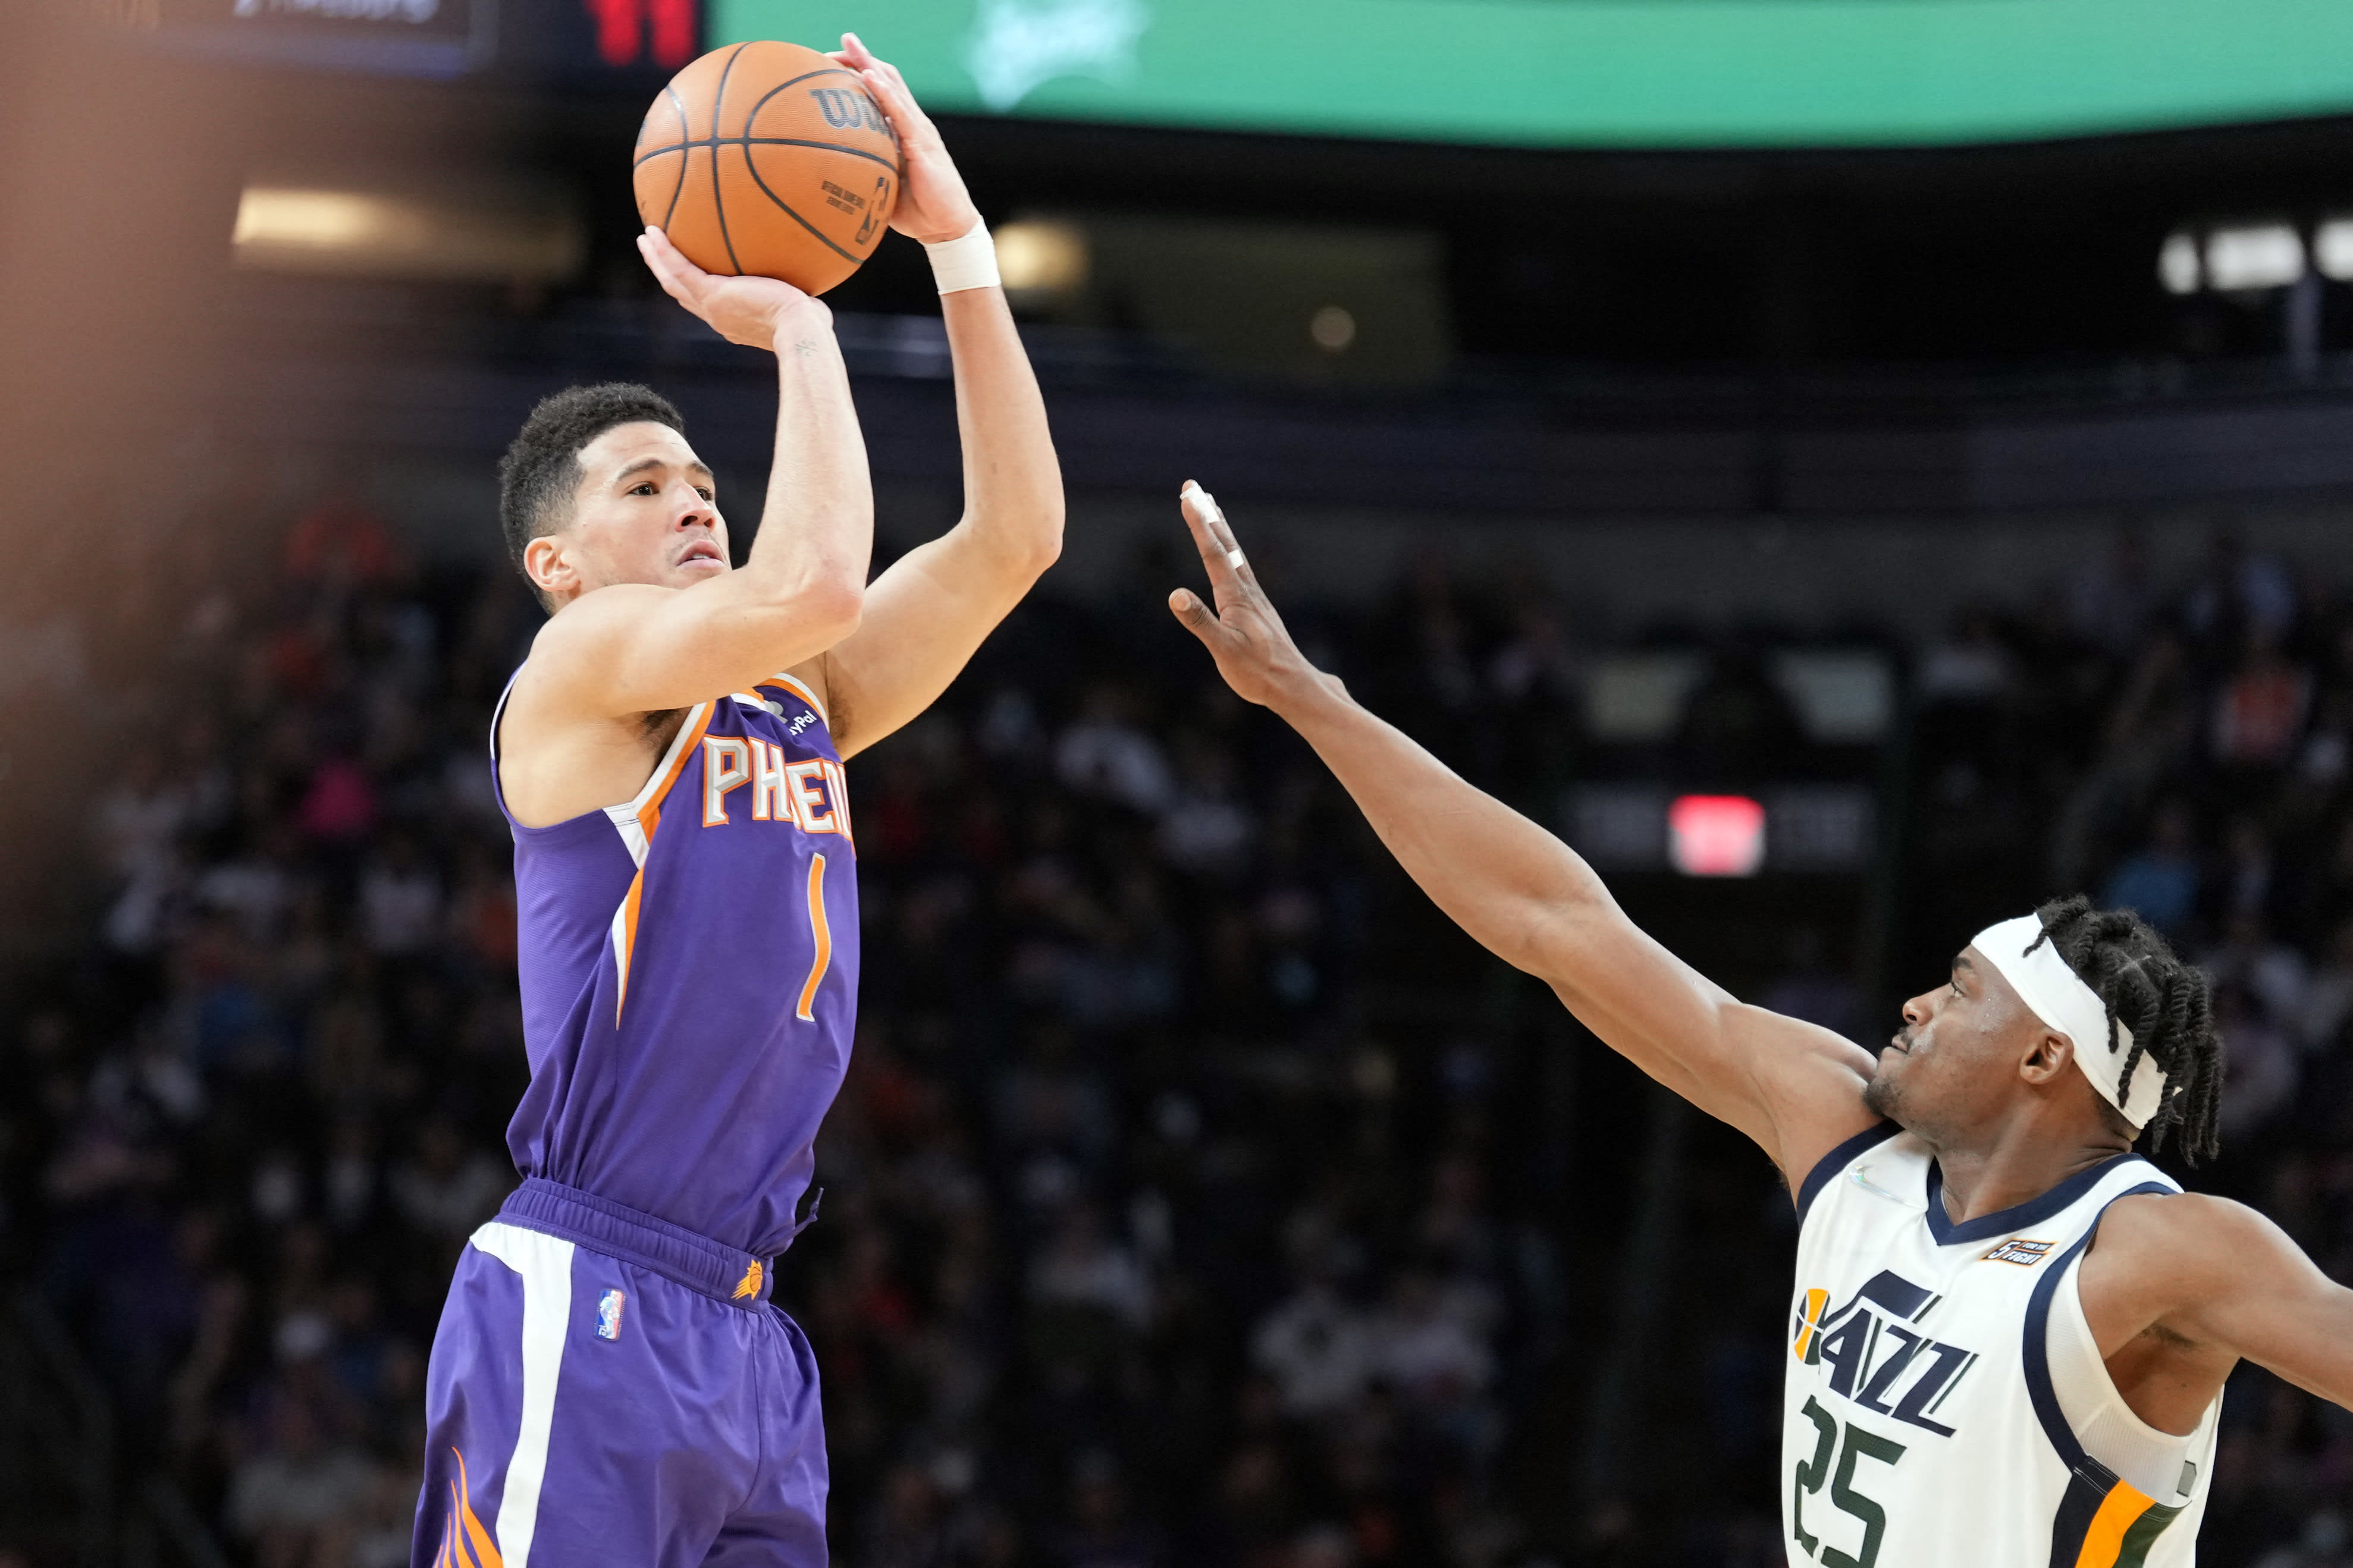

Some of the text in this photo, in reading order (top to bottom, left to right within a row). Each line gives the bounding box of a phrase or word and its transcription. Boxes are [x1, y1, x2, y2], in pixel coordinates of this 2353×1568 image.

[702, 734, 854, 843] PHEN
[796, 852, 832, 1022] 1
[1987, 1241, 2021, 1259] 5
[2002, 1250, 2042, 1264] FIGHT
[1794, 1394, 1908, 1568] 25
